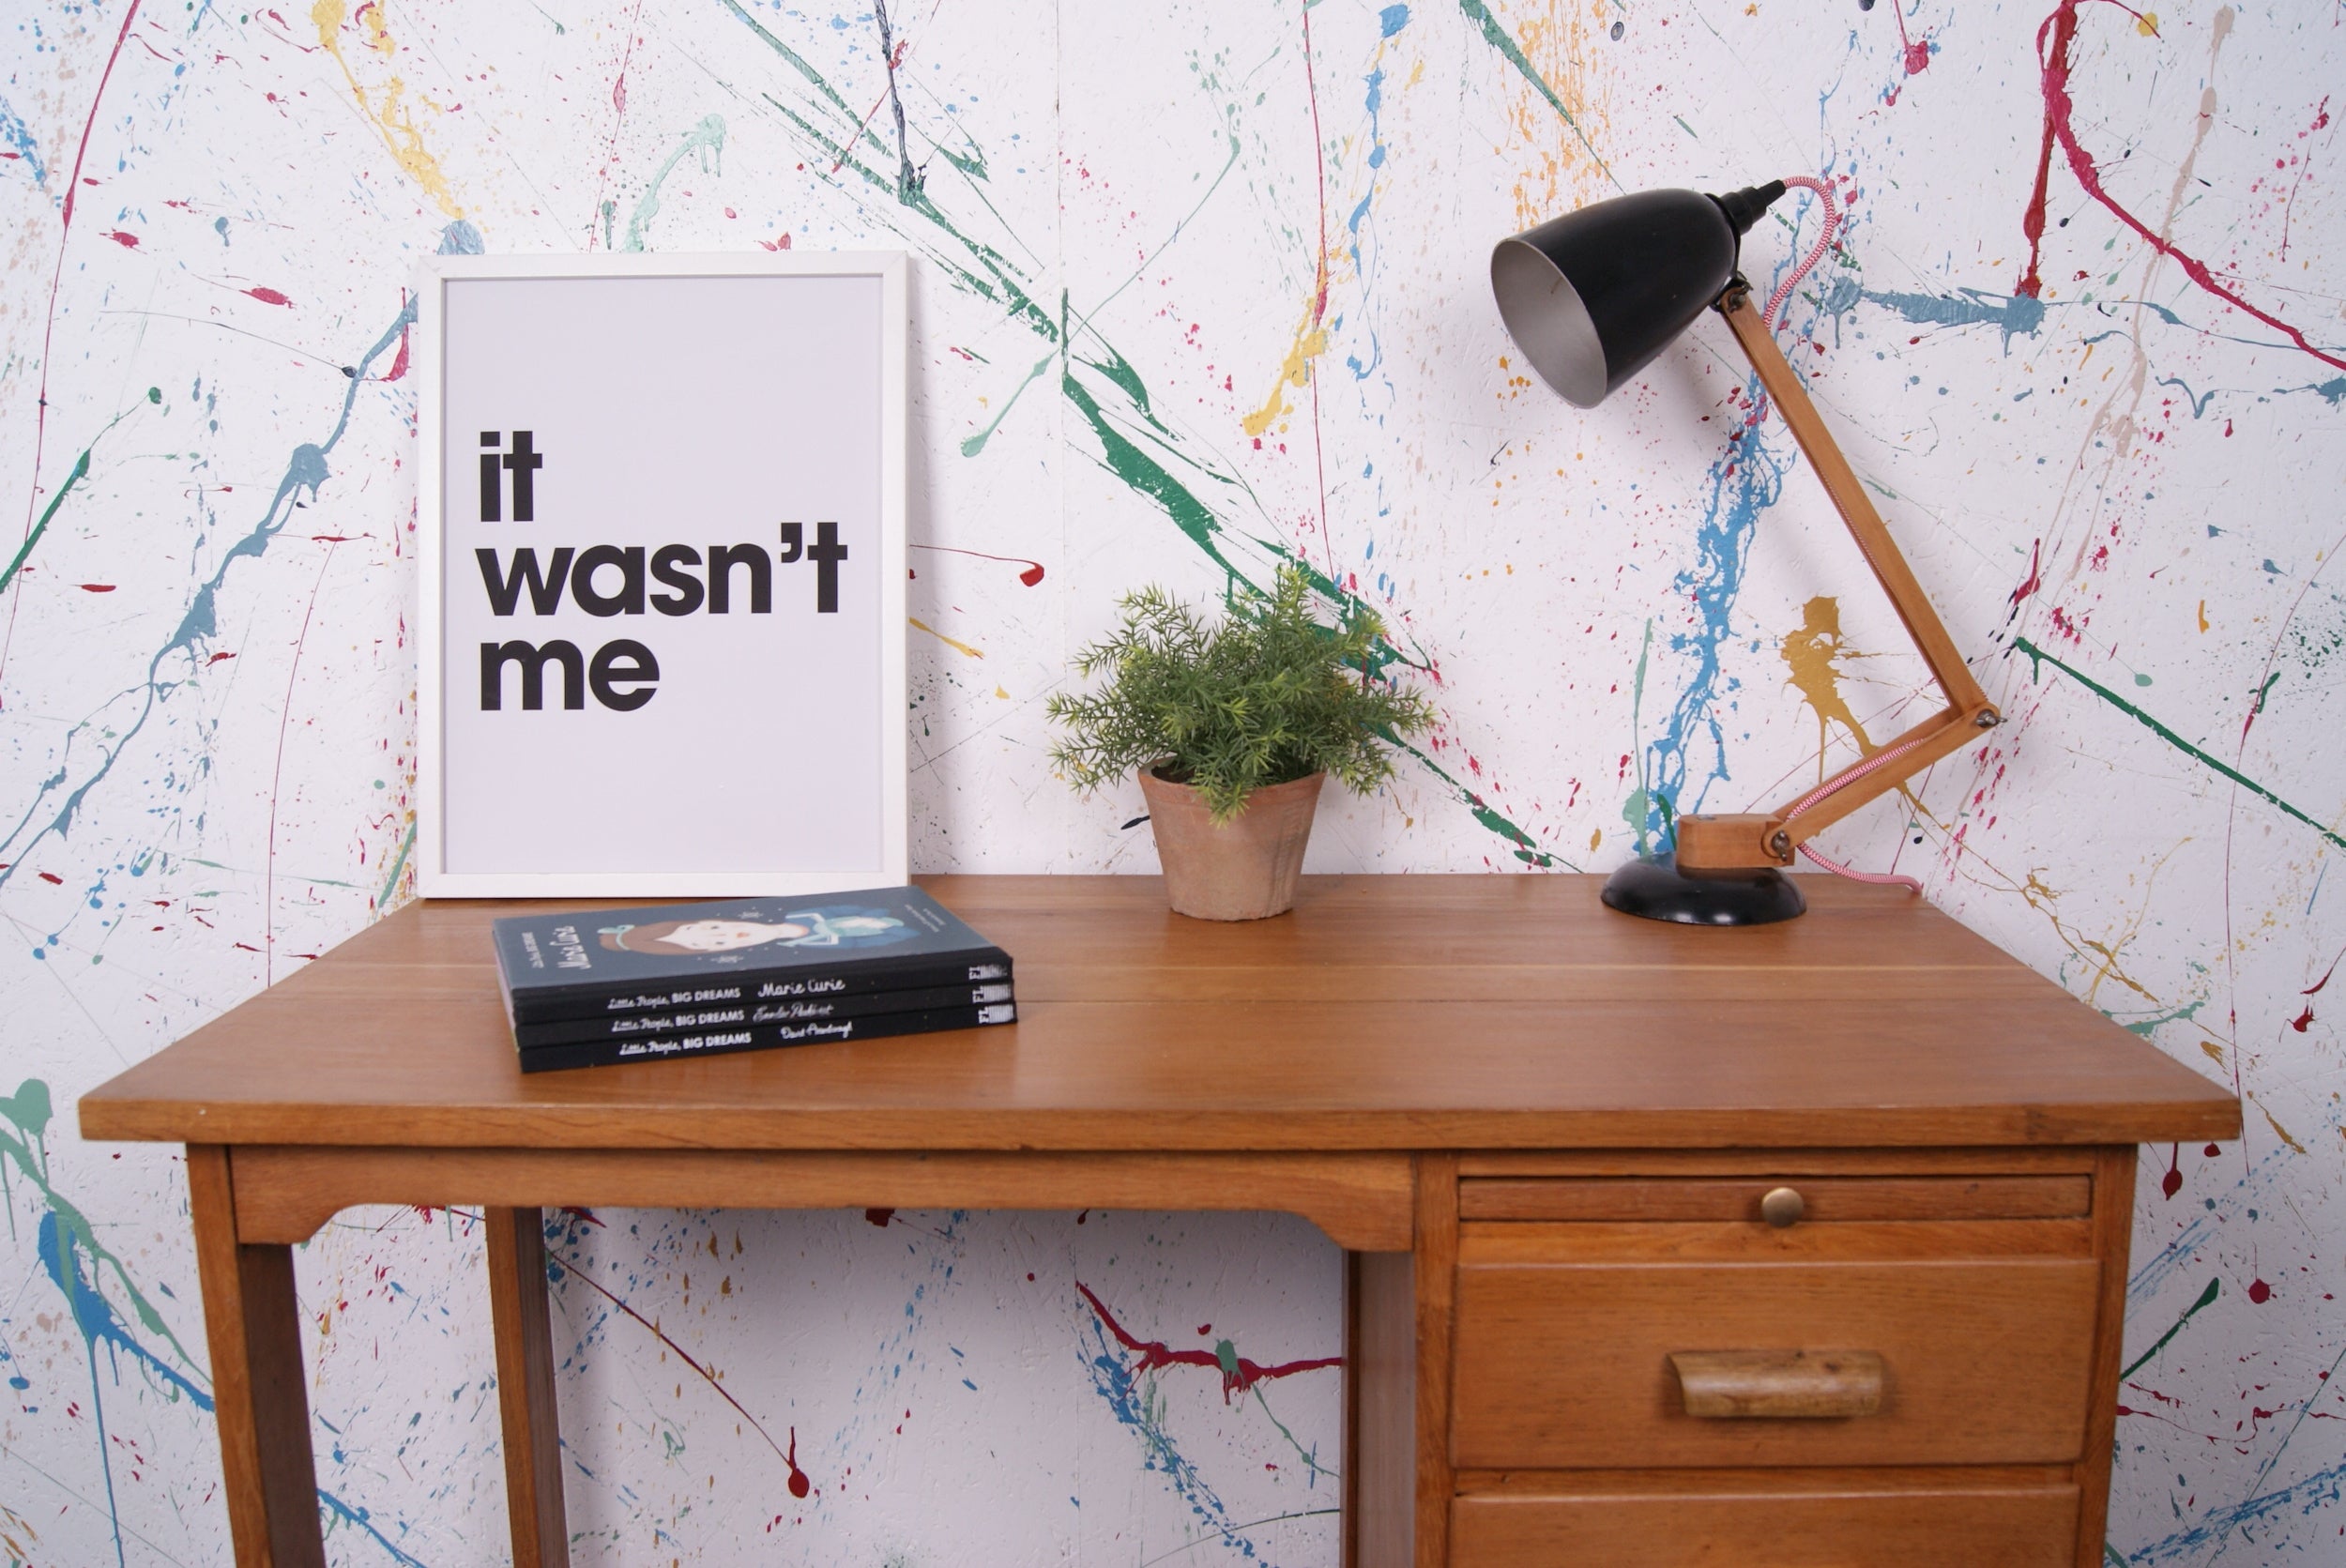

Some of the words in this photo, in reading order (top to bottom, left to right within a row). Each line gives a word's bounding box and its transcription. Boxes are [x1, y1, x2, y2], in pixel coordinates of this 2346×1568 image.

[480, 431, 542, 523] it
[475, 522, 848, 617] wasn’t
[480, 638, 660, 711] me
[671, 992, 693, 1003] BIG
[694, 987, 741, 1002] DREAMS
[757, 982, 806, 997] Marie
[807, 978, 846, 993] Curie
[676, 1014, 696, 1027] BIG
[698, 1009, 745, 1025] DREAMS
[683, 1037, 704, 1050] BIG
[705, 1032, 753, 1048] DREAMS
